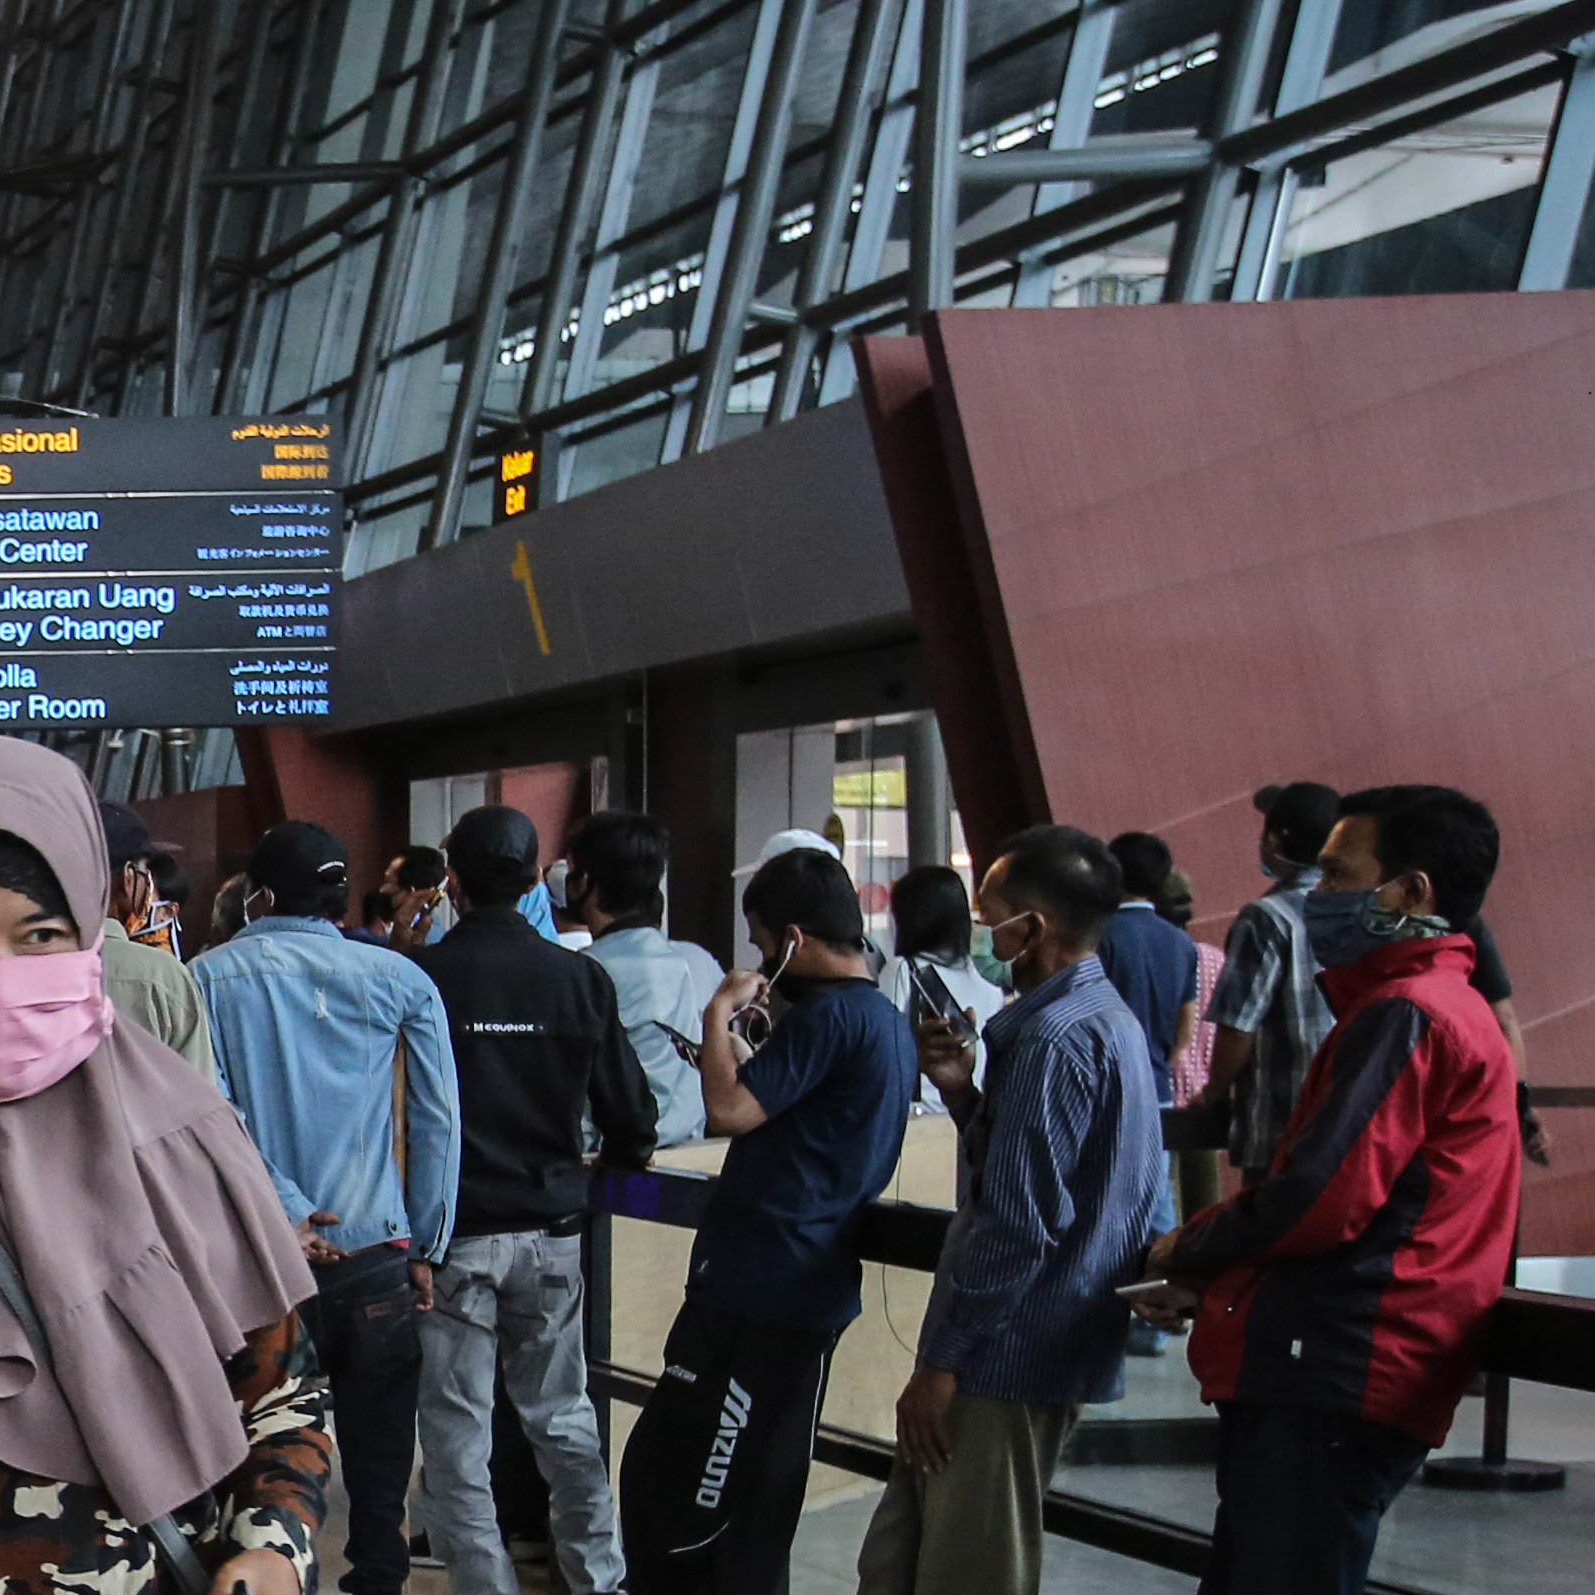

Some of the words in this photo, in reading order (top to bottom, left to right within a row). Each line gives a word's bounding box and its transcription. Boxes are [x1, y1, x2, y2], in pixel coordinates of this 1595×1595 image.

[98, 583, 175, 613] Uang
[40, 615, 164, 645] Changer
[28, 694, 106, 719] Room
[695, 1376, 753, 1509] MIZUNO
